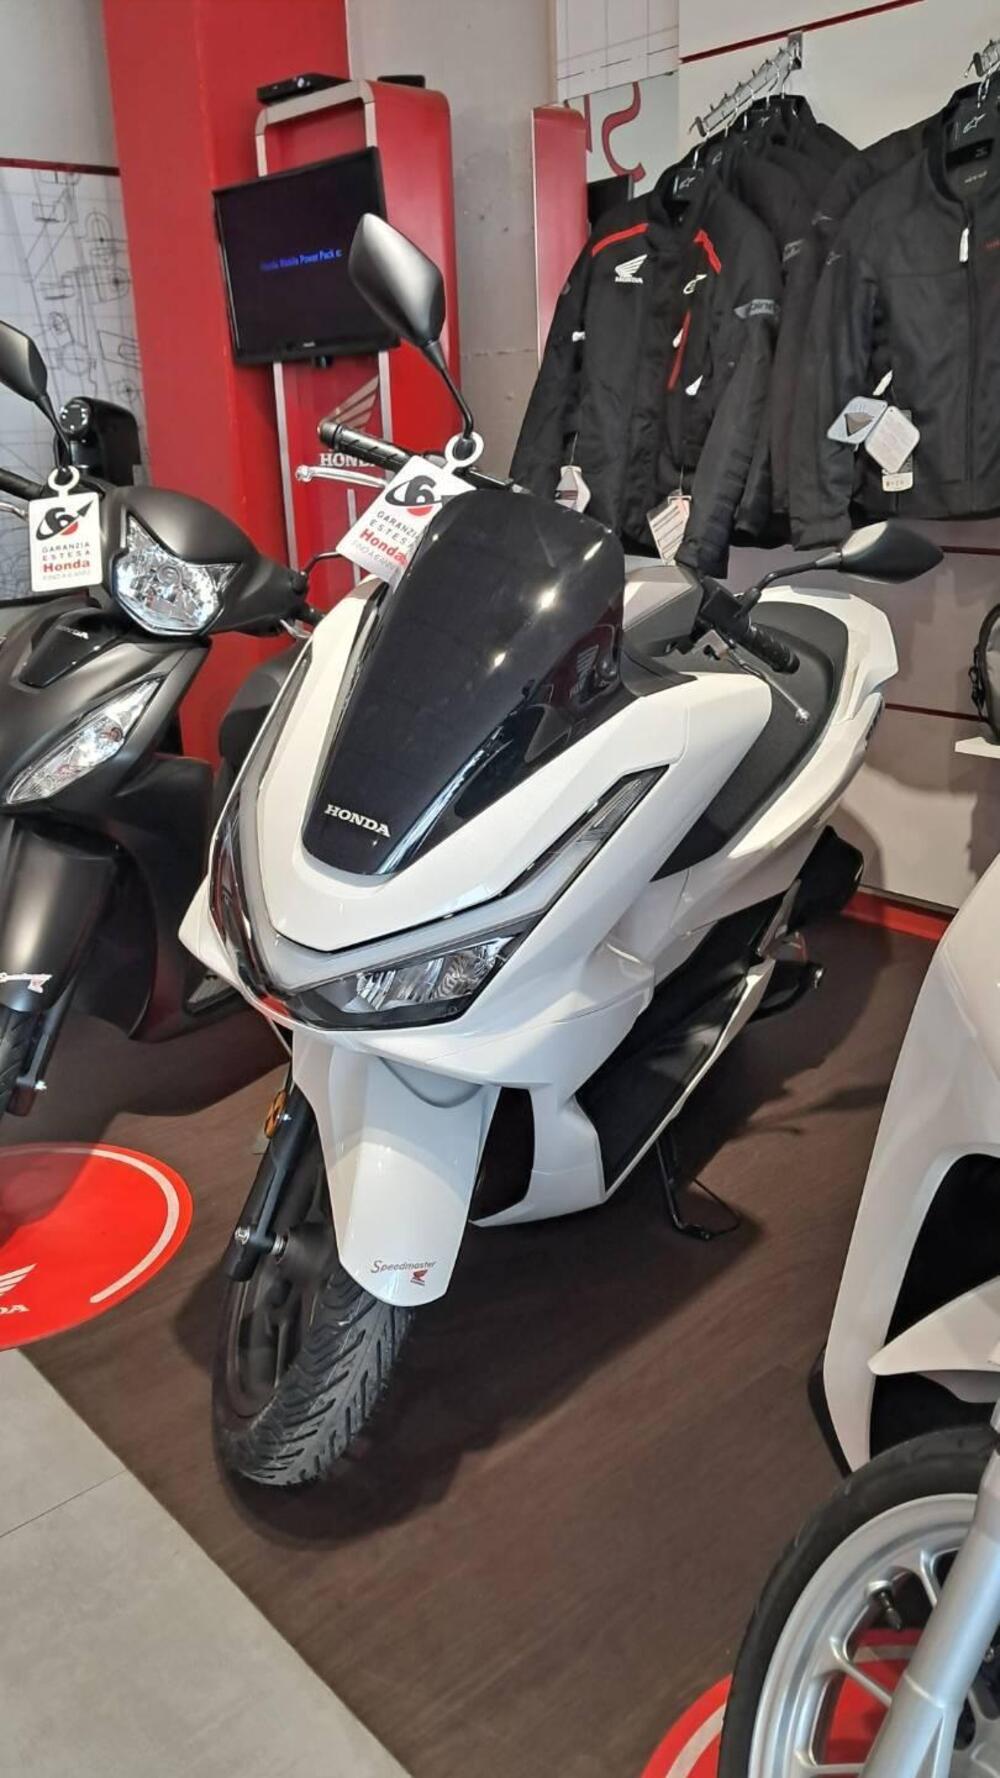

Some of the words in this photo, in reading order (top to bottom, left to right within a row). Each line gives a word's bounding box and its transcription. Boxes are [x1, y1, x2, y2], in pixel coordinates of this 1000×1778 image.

[320, 249, 335, 261] Pack
[42, 542, 90, 553] GARANZIA
[360, 527, 407, 565] Honda
[42, 549, 90, 562] ESTESA
[43, 558, 90, 573] Honda
[324, 803, 391, 838] HONDA
[370, 1259, 437, 1274] Speedmaster
